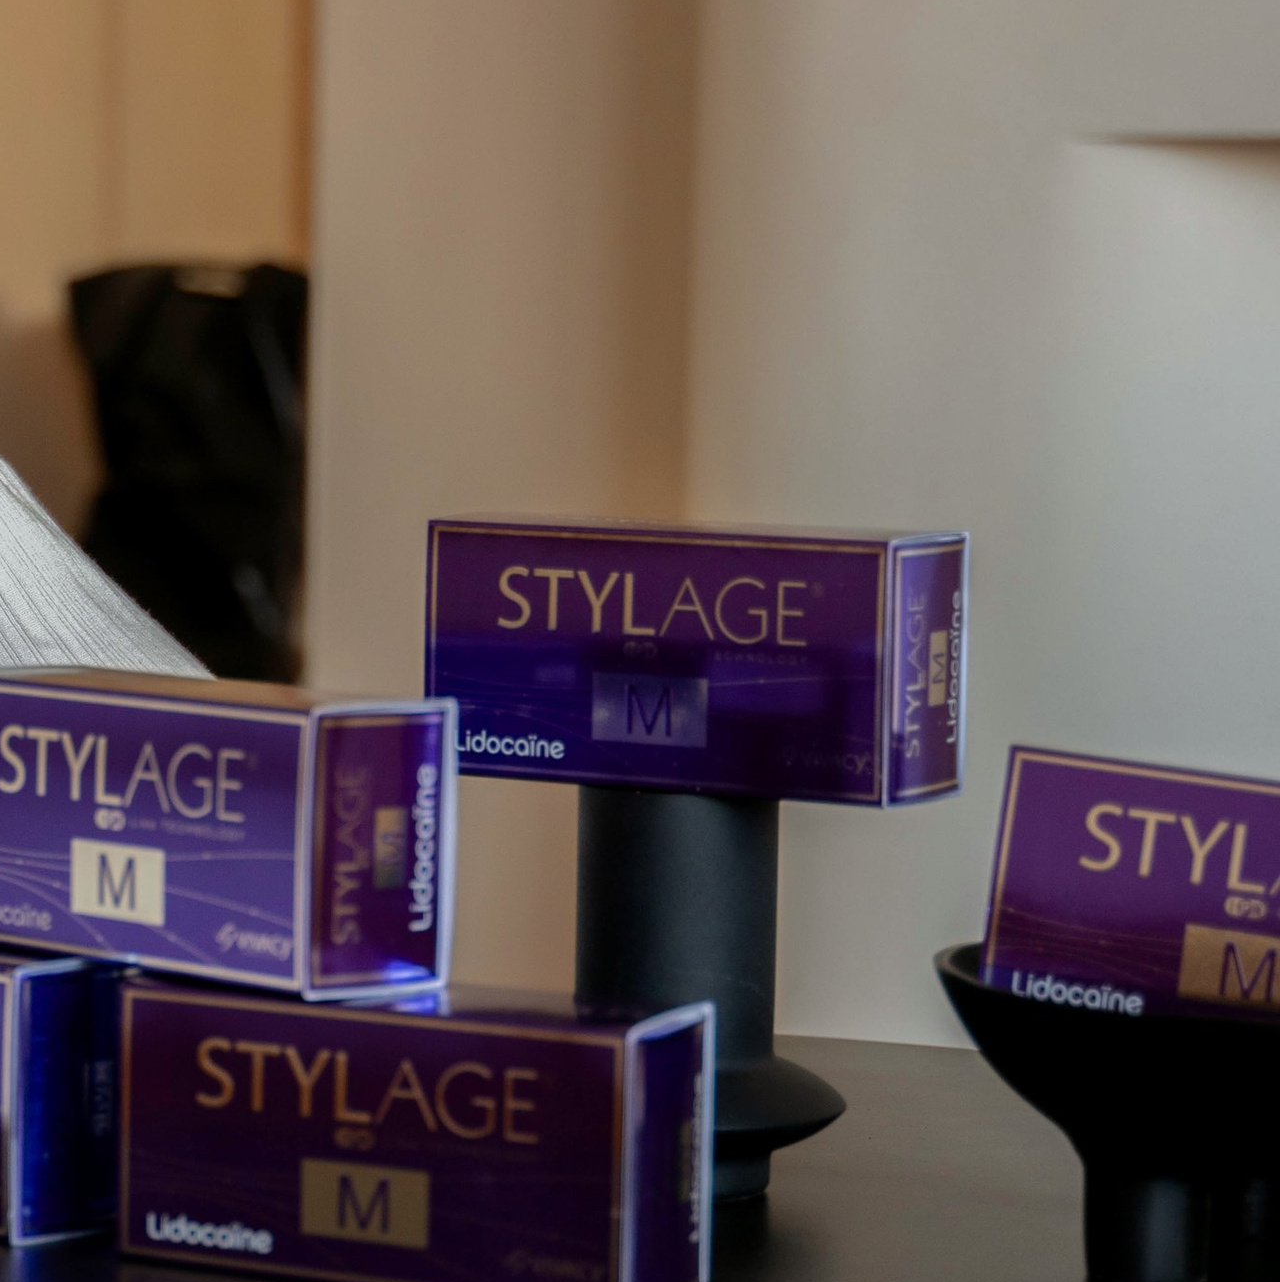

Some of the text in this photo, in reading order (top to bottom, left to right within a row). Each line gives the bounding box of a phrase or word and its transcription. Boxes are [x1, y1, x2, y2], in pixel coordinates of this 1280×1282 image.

[497, 565, 807, 647] STYLAGE
[626, 684, 671, 738] M
[454, 729, 565, 759] Lidocaïne
[1078, 802, 1280, 895] STYL
[98, 853, 138, 912] M
[1012, 971, 1144, 1016] Lidocaïne
[1219, 941, 1277, 1003] M
[195, 1036, 540, 1145] STYLAGE
[336, 1175, 391, 1234] M
